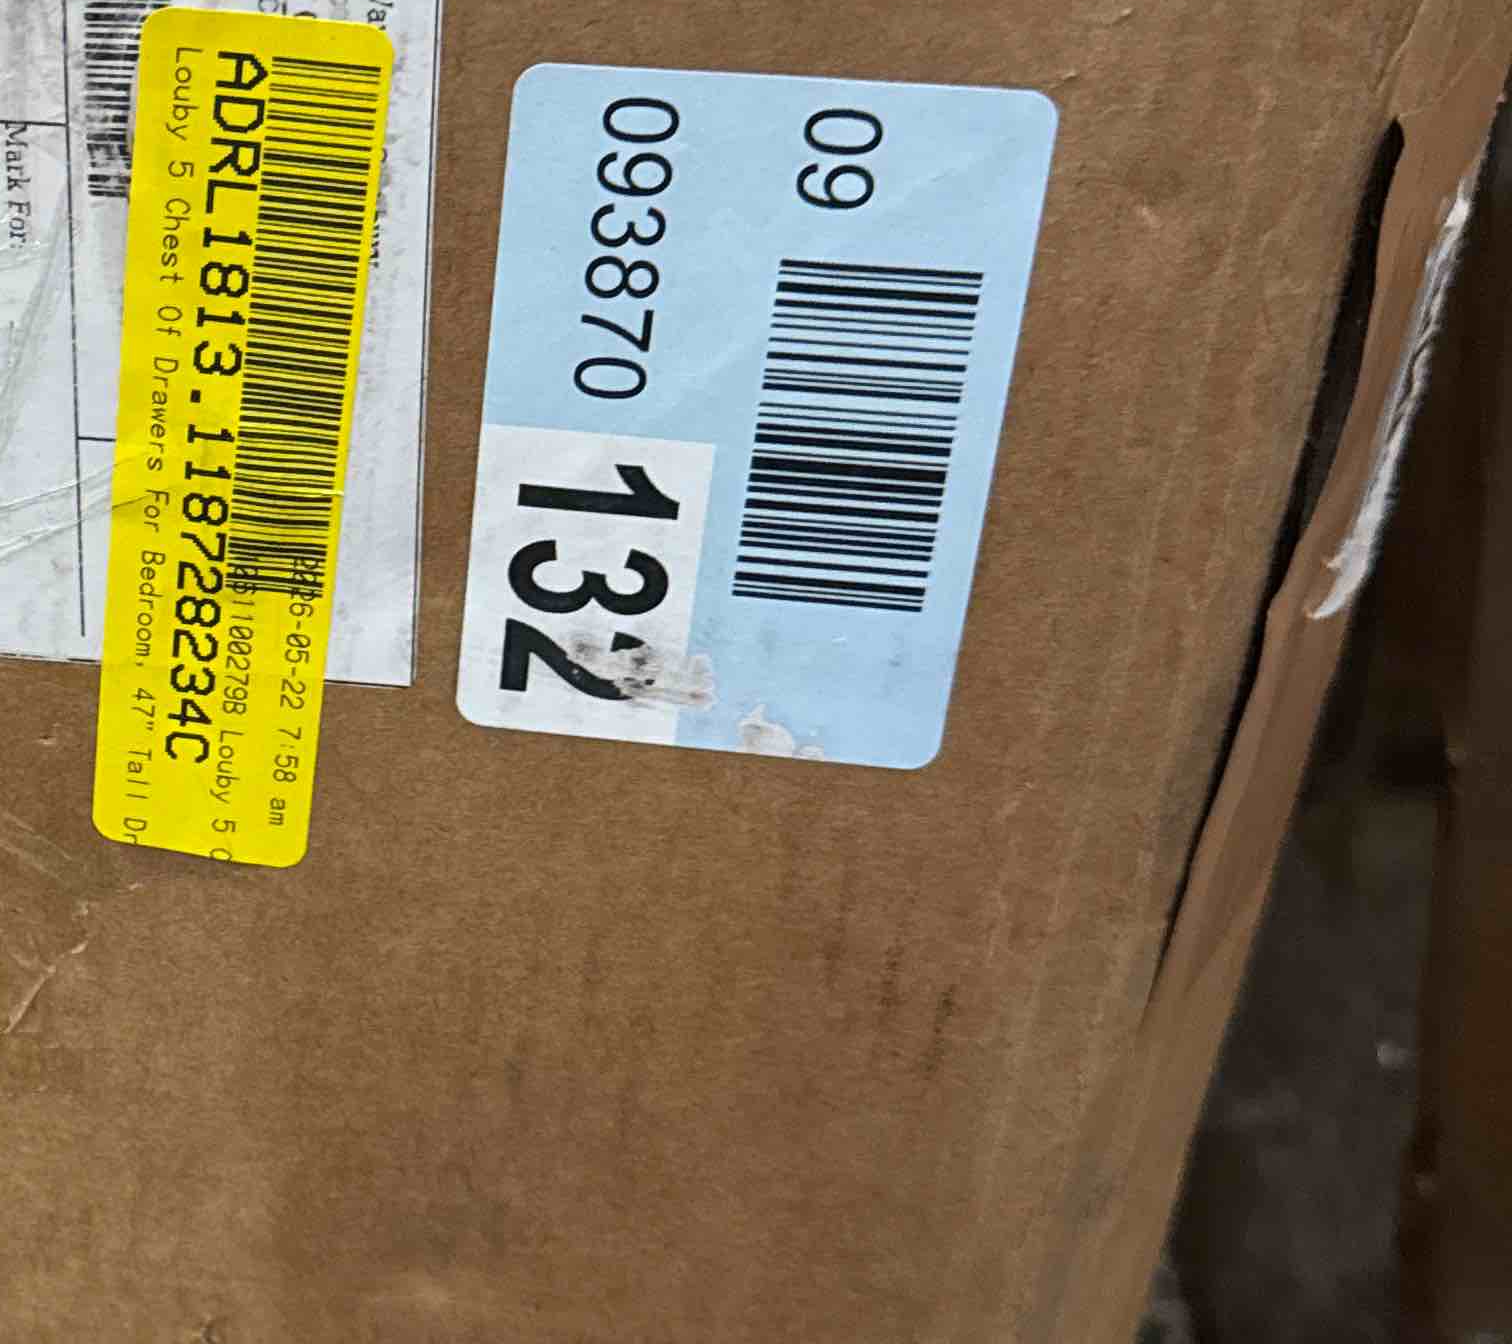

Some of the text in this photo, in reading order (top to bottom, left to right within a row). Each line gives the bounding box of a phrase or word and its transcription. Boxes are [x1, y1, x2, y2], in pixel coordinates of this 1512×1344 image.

[165, 47, 204, 143] Louby
[5, 123, 32, 250] Mark For:
[167, 160, 195, 179] 5
[795, 105, 884, 212] 09
[159, 197, 192, 284] Chest
[572, 96, 681, 401] 093870
[156, 303, 184, 338] Of
[146, 355, 180, 472] Drawers
[163, 50, 268, 766] ADRL1813.118728234C
[142, 489, 170, 534] For
[135, 548, 167, 668] Bedroom,
[497, 462, 681, 703] 132
[129, 687, 156, 732] 47"
[267, 556, 322, 827] 2026-05-22 7:58 am
[126, 749, 152, 801] Tall
[208, 729, 242, 804] Louby
[211, 818, 236, 833] 5
